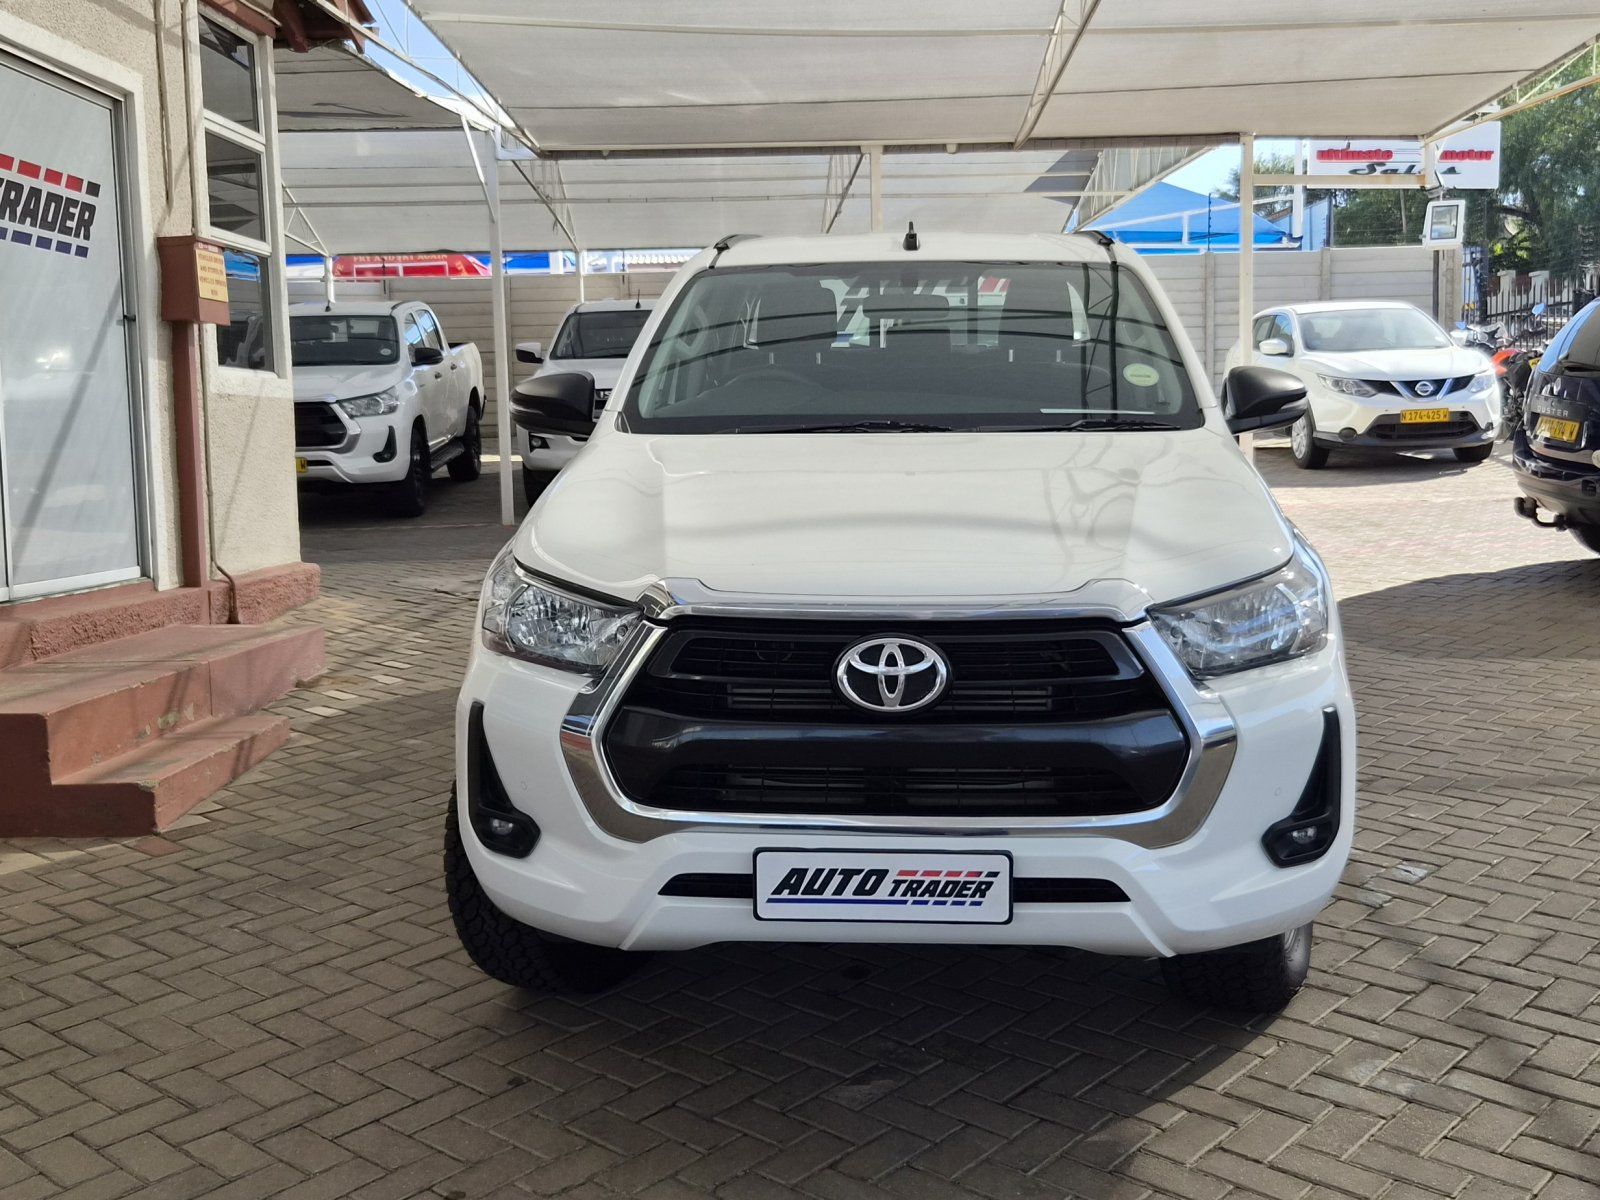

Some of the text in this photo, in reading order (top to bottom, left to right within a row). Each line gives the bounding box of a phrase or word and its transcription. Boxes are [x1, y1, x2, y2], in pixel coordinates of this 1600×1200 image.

[1439, 149, 1494, 161] motor
[1348, 162, 1461, 176] Sals
[0, 177, 96, 241] RADER
[1537, 405, 1569, 417] DUSTER
[770, 867, 994, 898] AUTO TRADER
